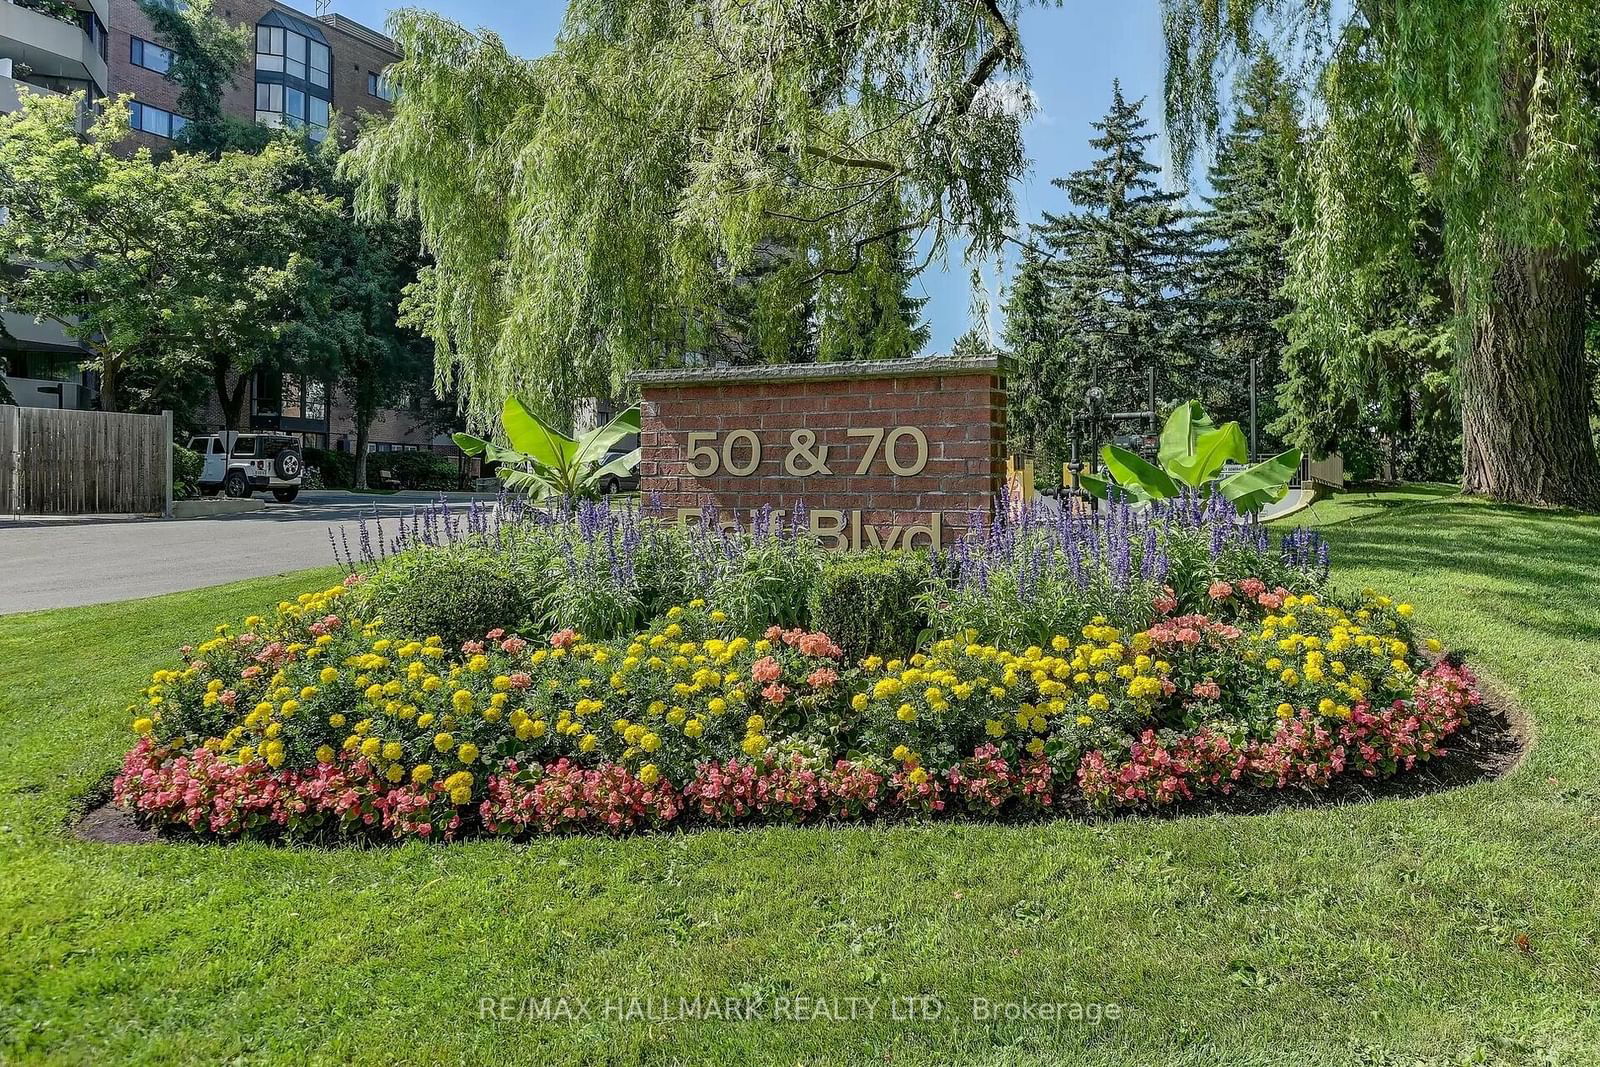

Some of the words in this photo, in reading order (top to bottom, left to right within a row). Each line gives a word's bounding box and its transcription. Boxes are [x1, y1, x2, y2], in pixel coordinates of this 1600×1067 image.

[685, 428, 762, 478] 50
[783, 428, 834, 476] &
[846, 425, 929, 477] 70
[808, 510, 942, 551] Blvd
